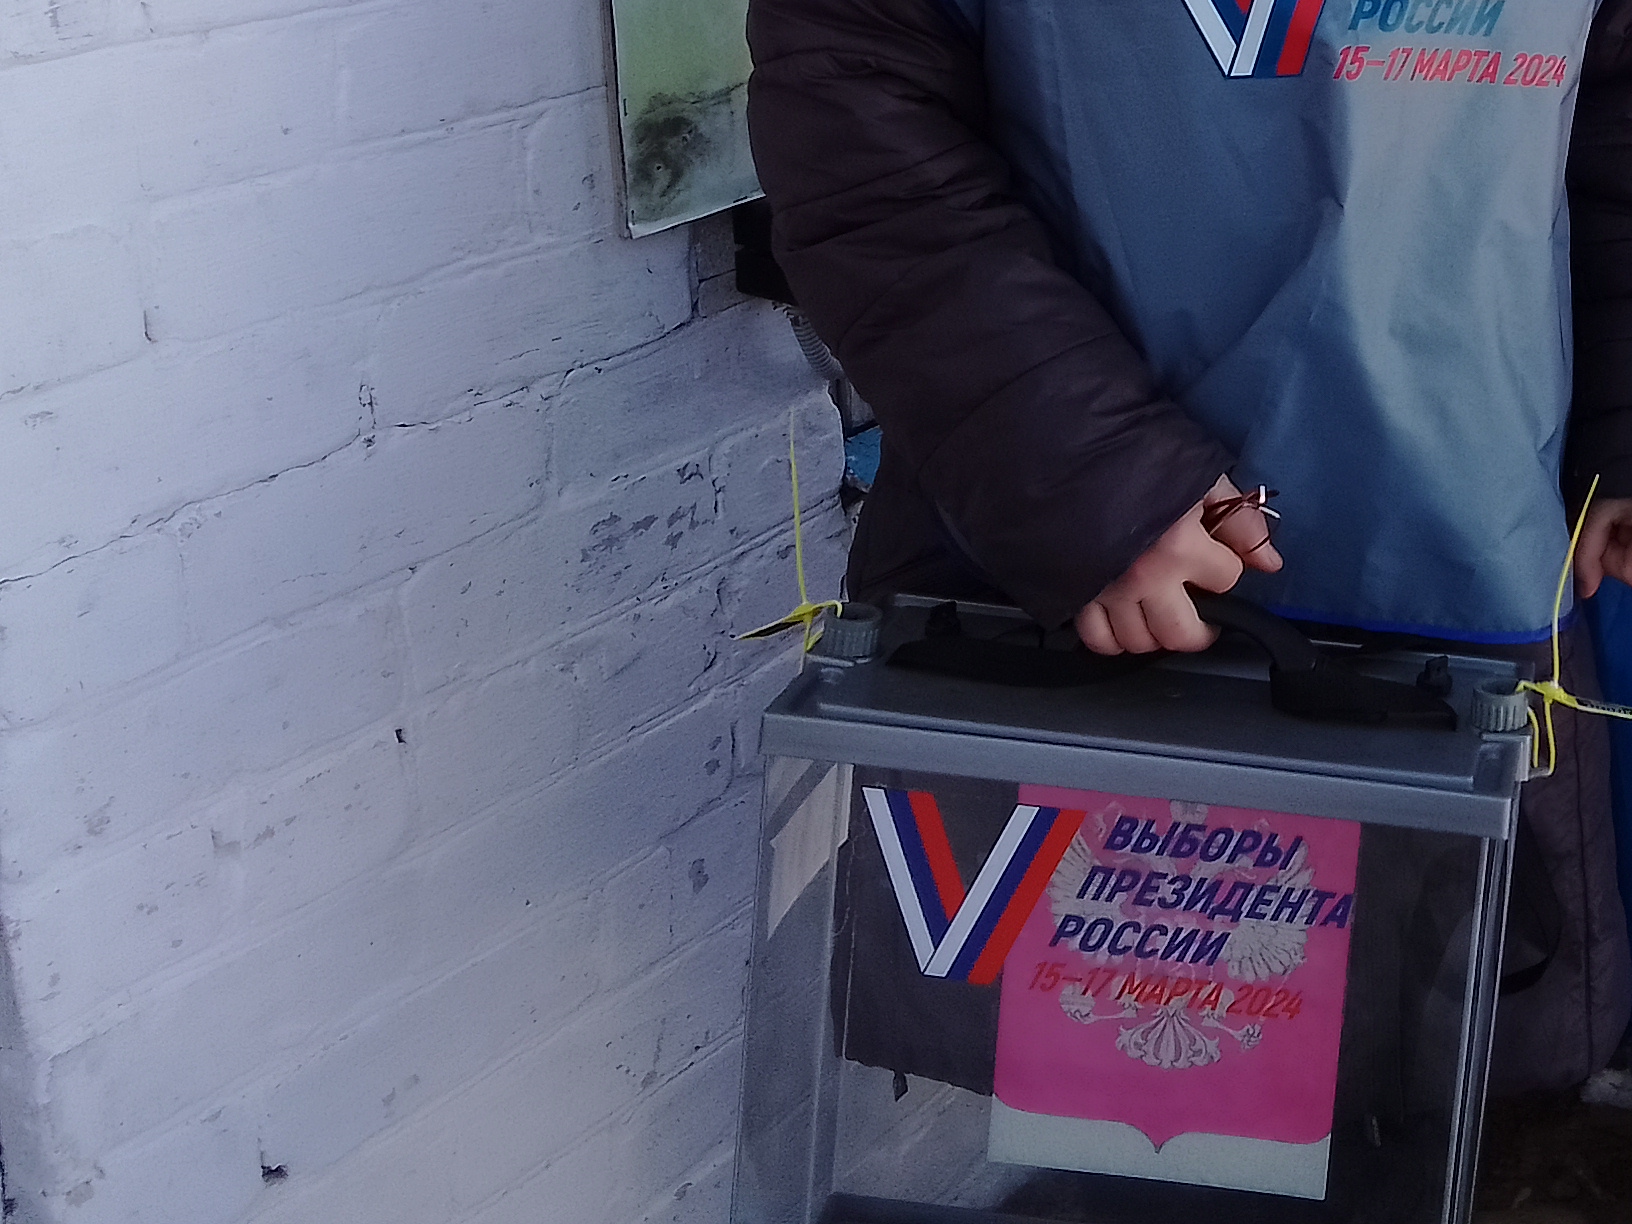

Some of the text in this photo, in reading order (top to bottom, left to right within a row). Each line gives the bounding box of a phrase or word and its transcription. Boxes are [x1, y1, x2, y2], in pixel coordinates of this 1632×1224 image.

[1332, 45, 1568, 88] 15–17 МАРТА 2024
[1102, 814, 1305, 871] ВЫБОРЫ
[1076, 865, 1355, 930] ПРЕЗИДЕНТА
[1048, 913, 1232, 966] РОССИИ
[1027, 960, 1304, 1020] 15–17 МАРТА 2024
